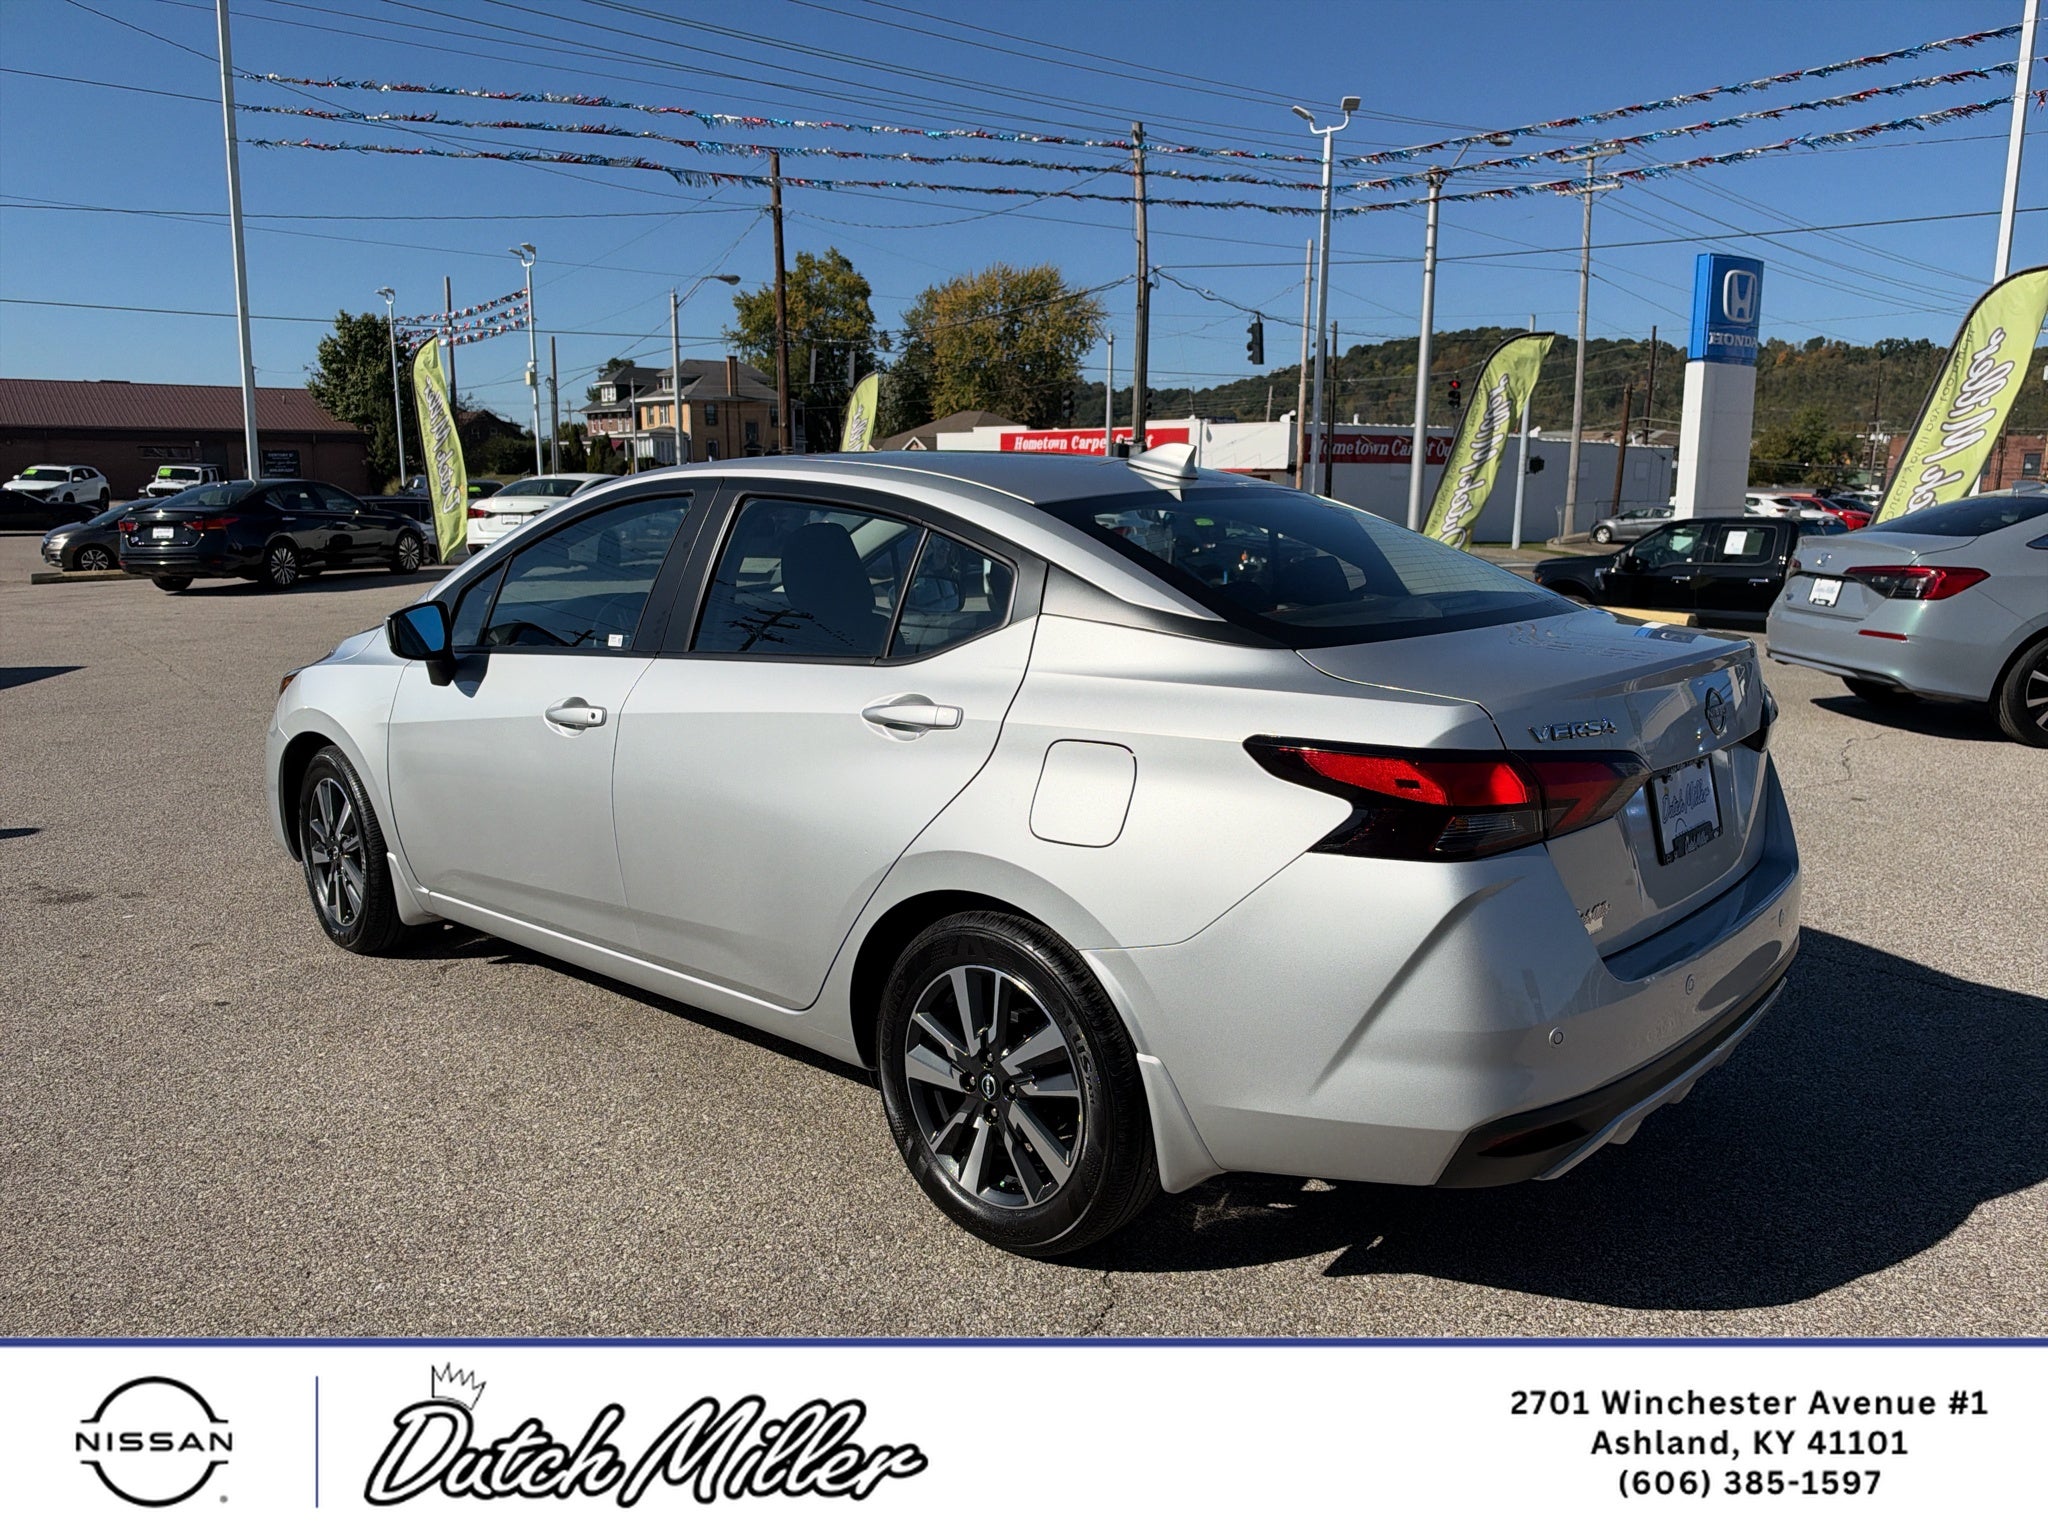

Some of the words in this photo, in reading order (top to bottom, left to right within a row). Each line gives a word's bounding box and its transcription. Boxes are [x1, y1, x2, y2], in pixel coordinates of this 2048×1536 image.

[1708, 331, 1758, 348] HONDA
[1014, 435, 1068, 451] Hometown
[1070, 435, 1113, 453] Carpe
[1528, 717, 1618, 743] VERSA
